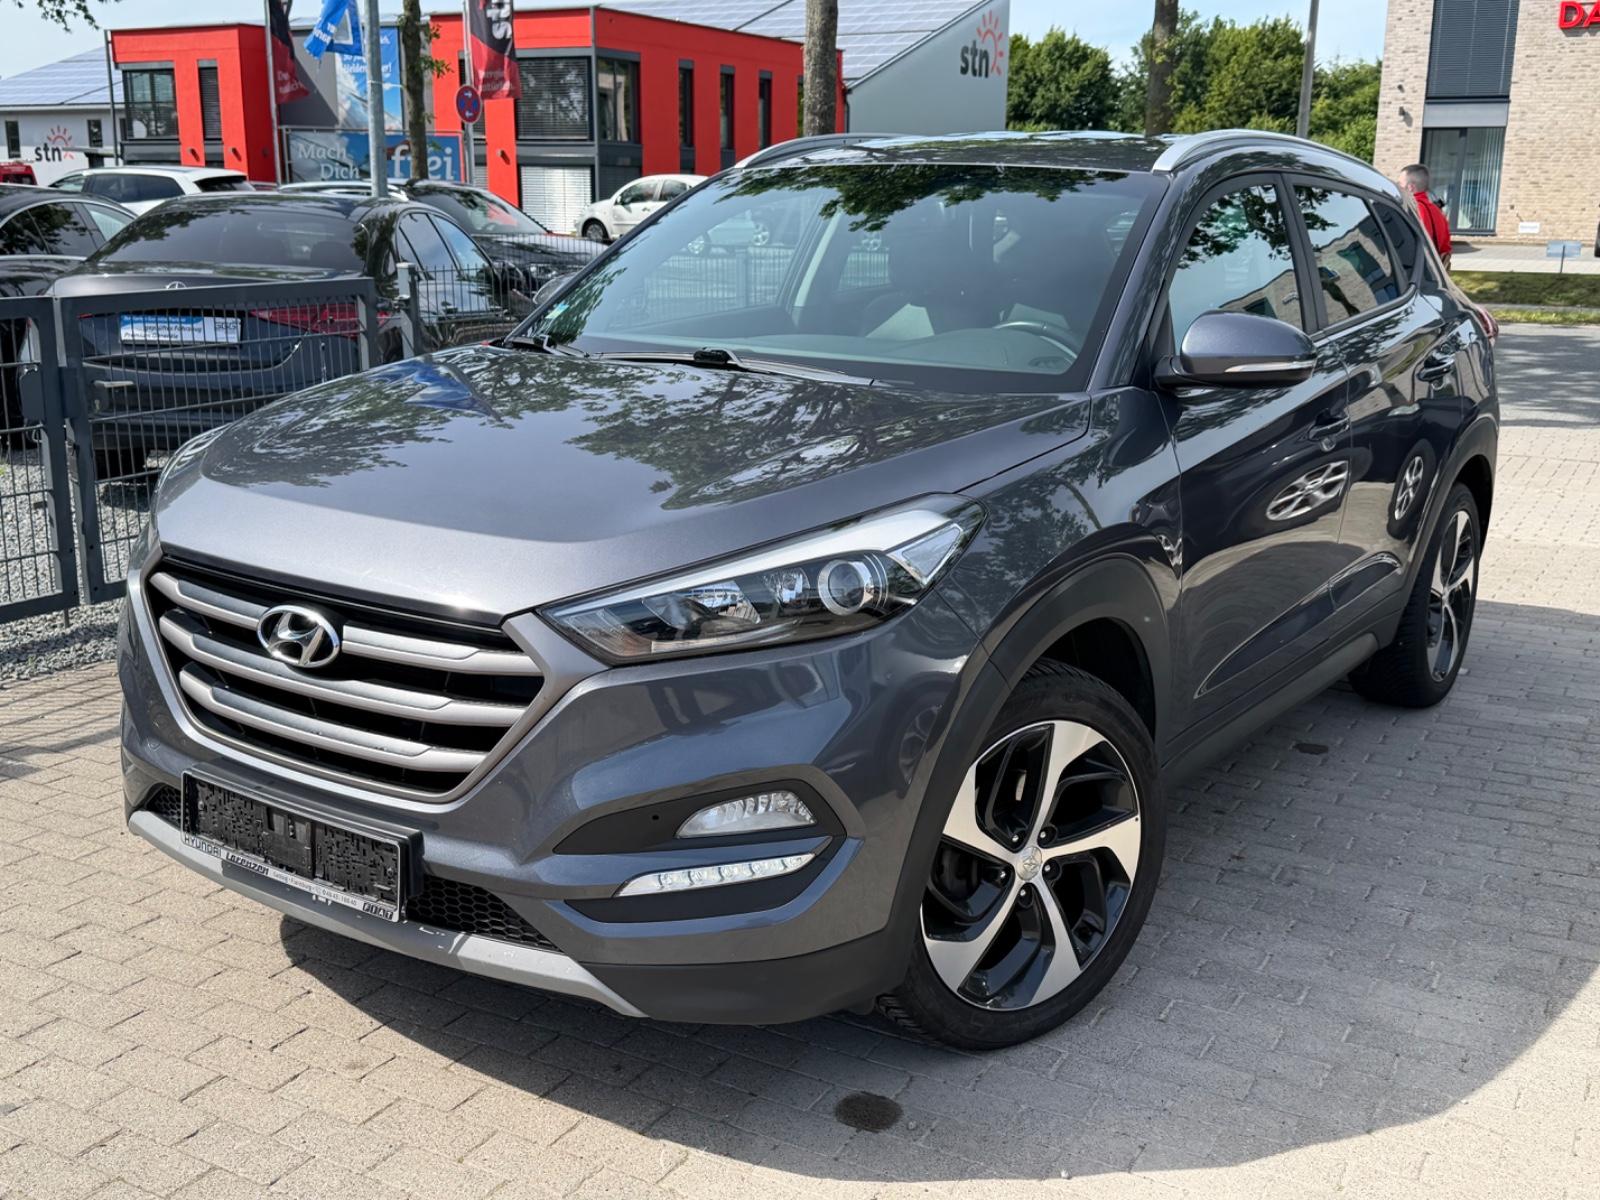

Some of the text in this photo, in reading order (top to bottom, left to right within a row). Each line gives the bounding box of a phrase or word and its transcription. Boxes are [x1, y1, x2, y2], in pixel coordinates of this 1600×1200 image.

[486, 0, 513, 39] st
[960, 40, 989, 78] stn
[35, 142, 62, 162] stn
[299, 143, 347, 160] Mach
[320, 162, 360, 180] Dich
[226, 851, 270, 875] Lorenzen
[363, 901, 395, 920] FIAT
